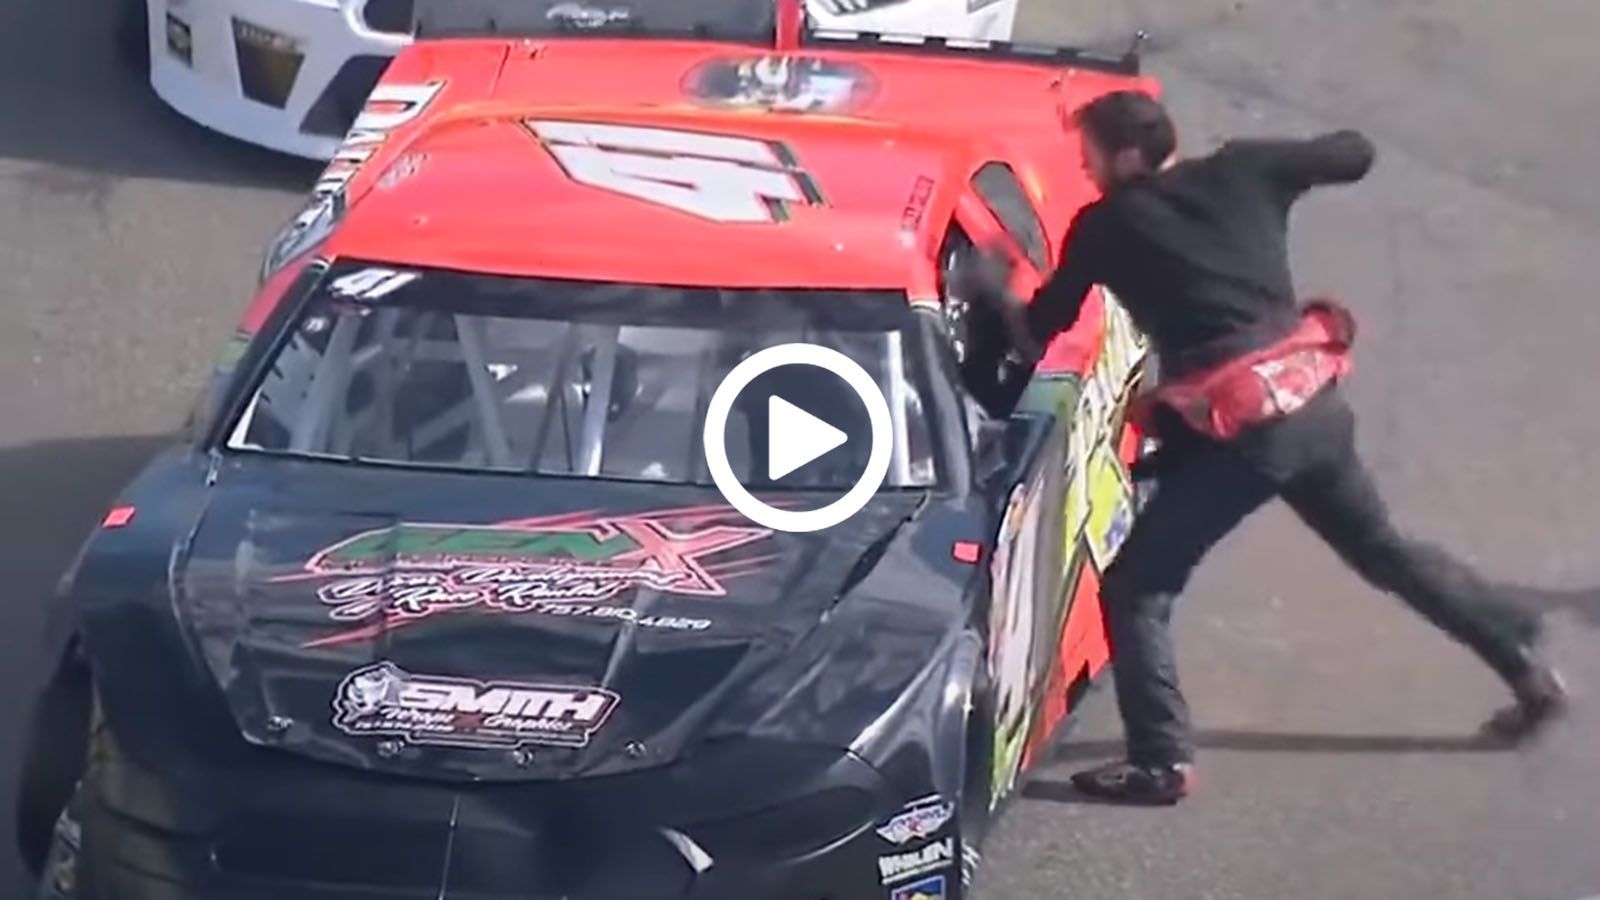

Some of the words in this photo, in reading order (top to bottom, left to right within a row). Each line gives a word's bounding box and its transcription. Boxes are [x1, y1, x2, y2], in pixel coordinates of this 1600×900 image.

[522, 117, 826, 225] 41
[328, 267, 424, 300] 41
[399, 681, 606, 722] SMITH
